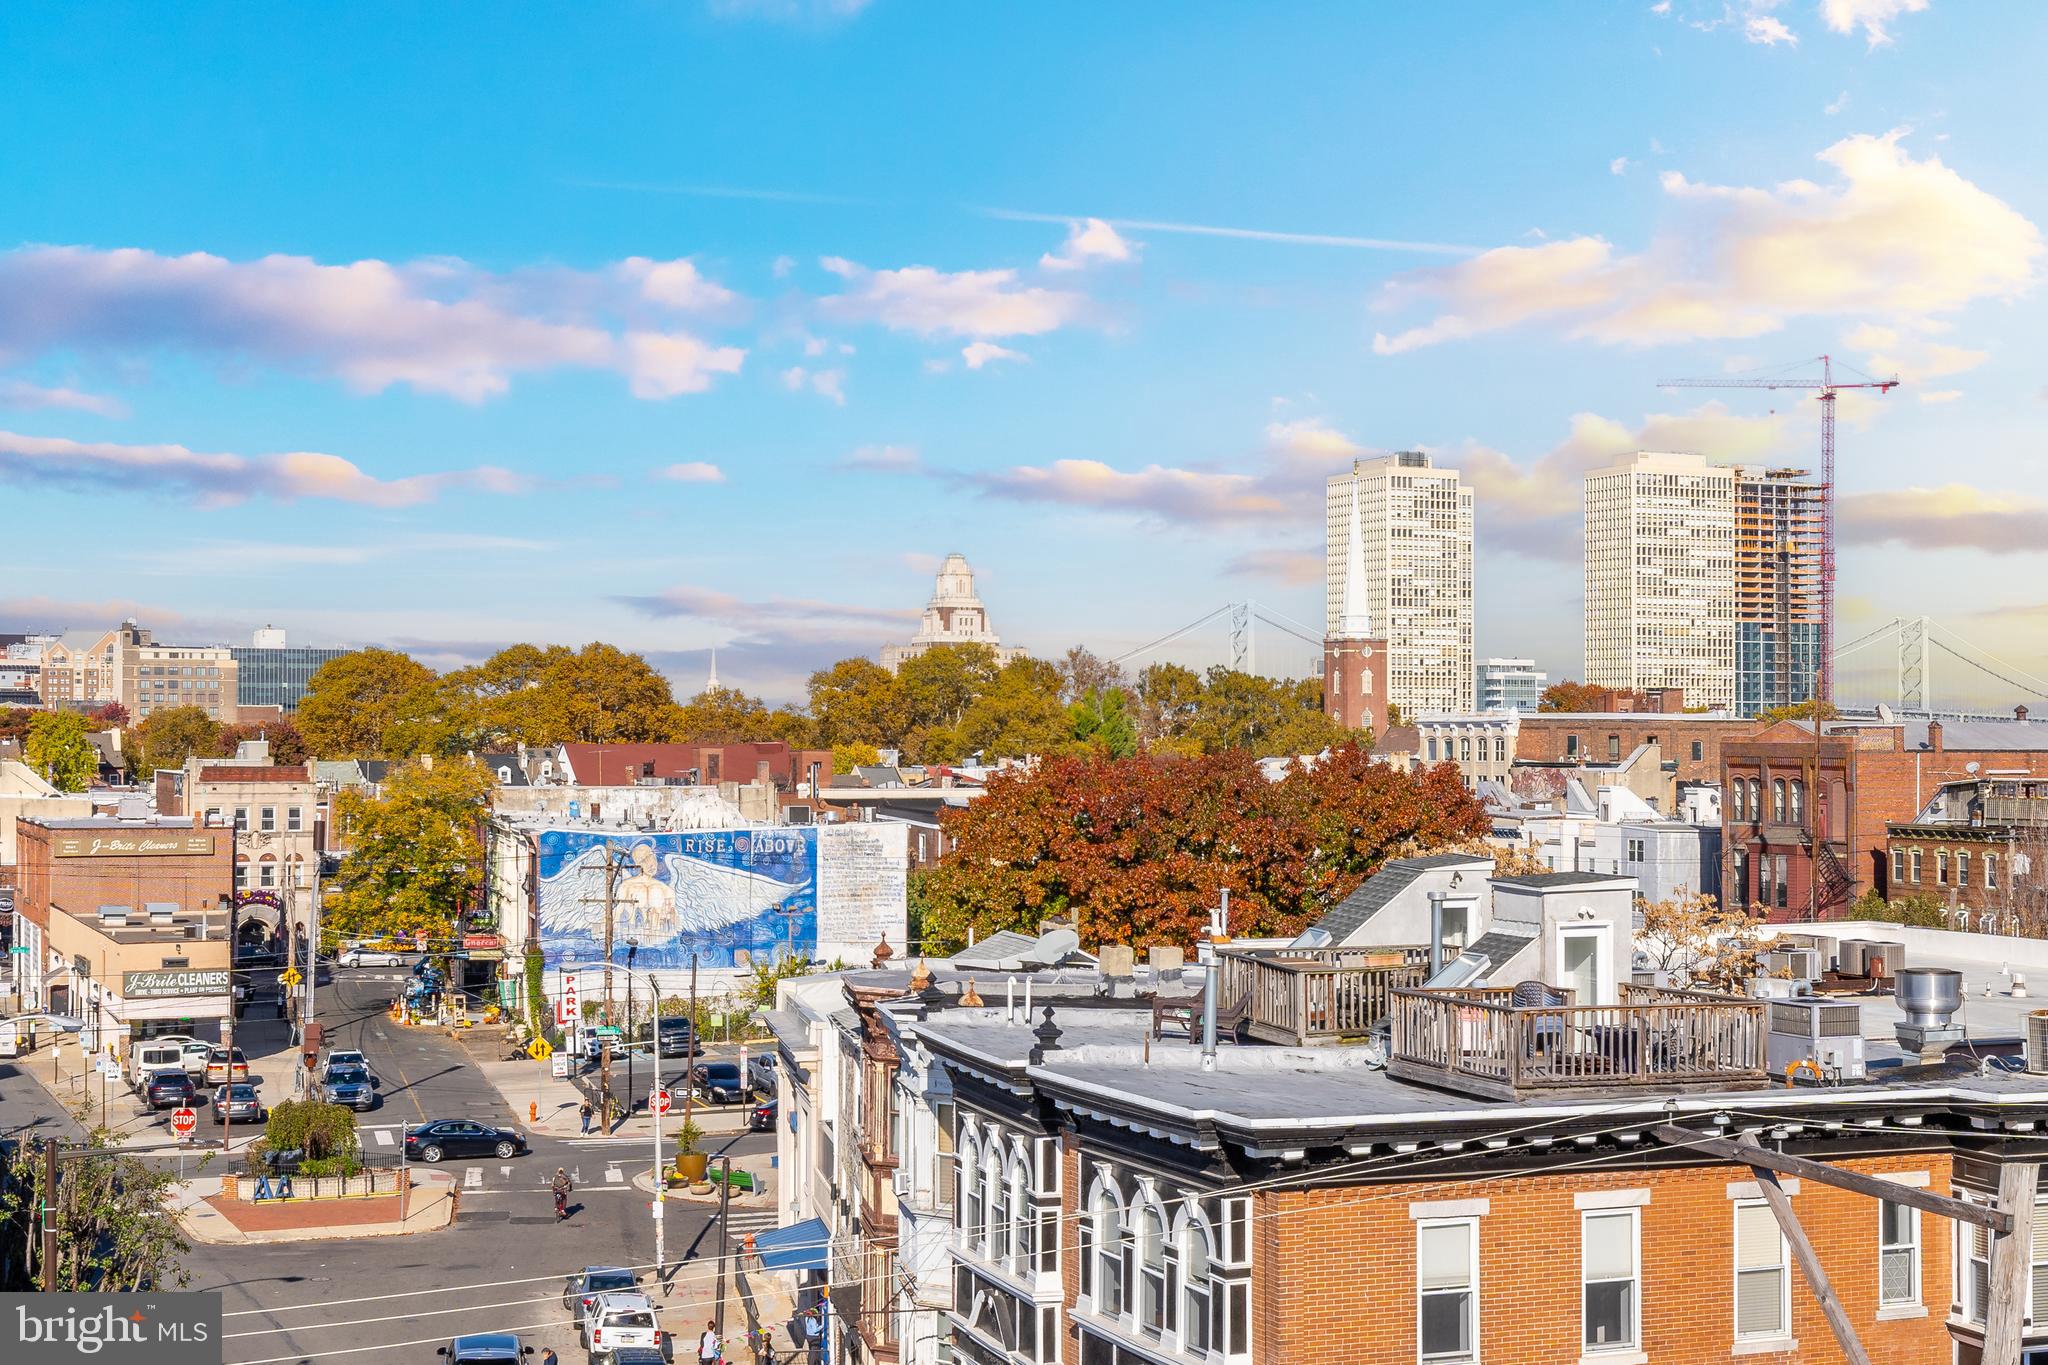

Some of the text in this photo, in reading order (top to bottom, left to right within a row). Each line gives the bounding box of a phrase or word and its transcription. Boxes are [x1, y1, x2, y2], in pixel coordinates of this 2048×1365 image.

[138, 840, 178, 852] Cleaners
[685, 839, 805, 853] RISE ABOVE
[178, 972, 229, 986] CLEANERS
[566, 976, 577, 1016] PARK
[173, 1115, 195, 1125] STOP
